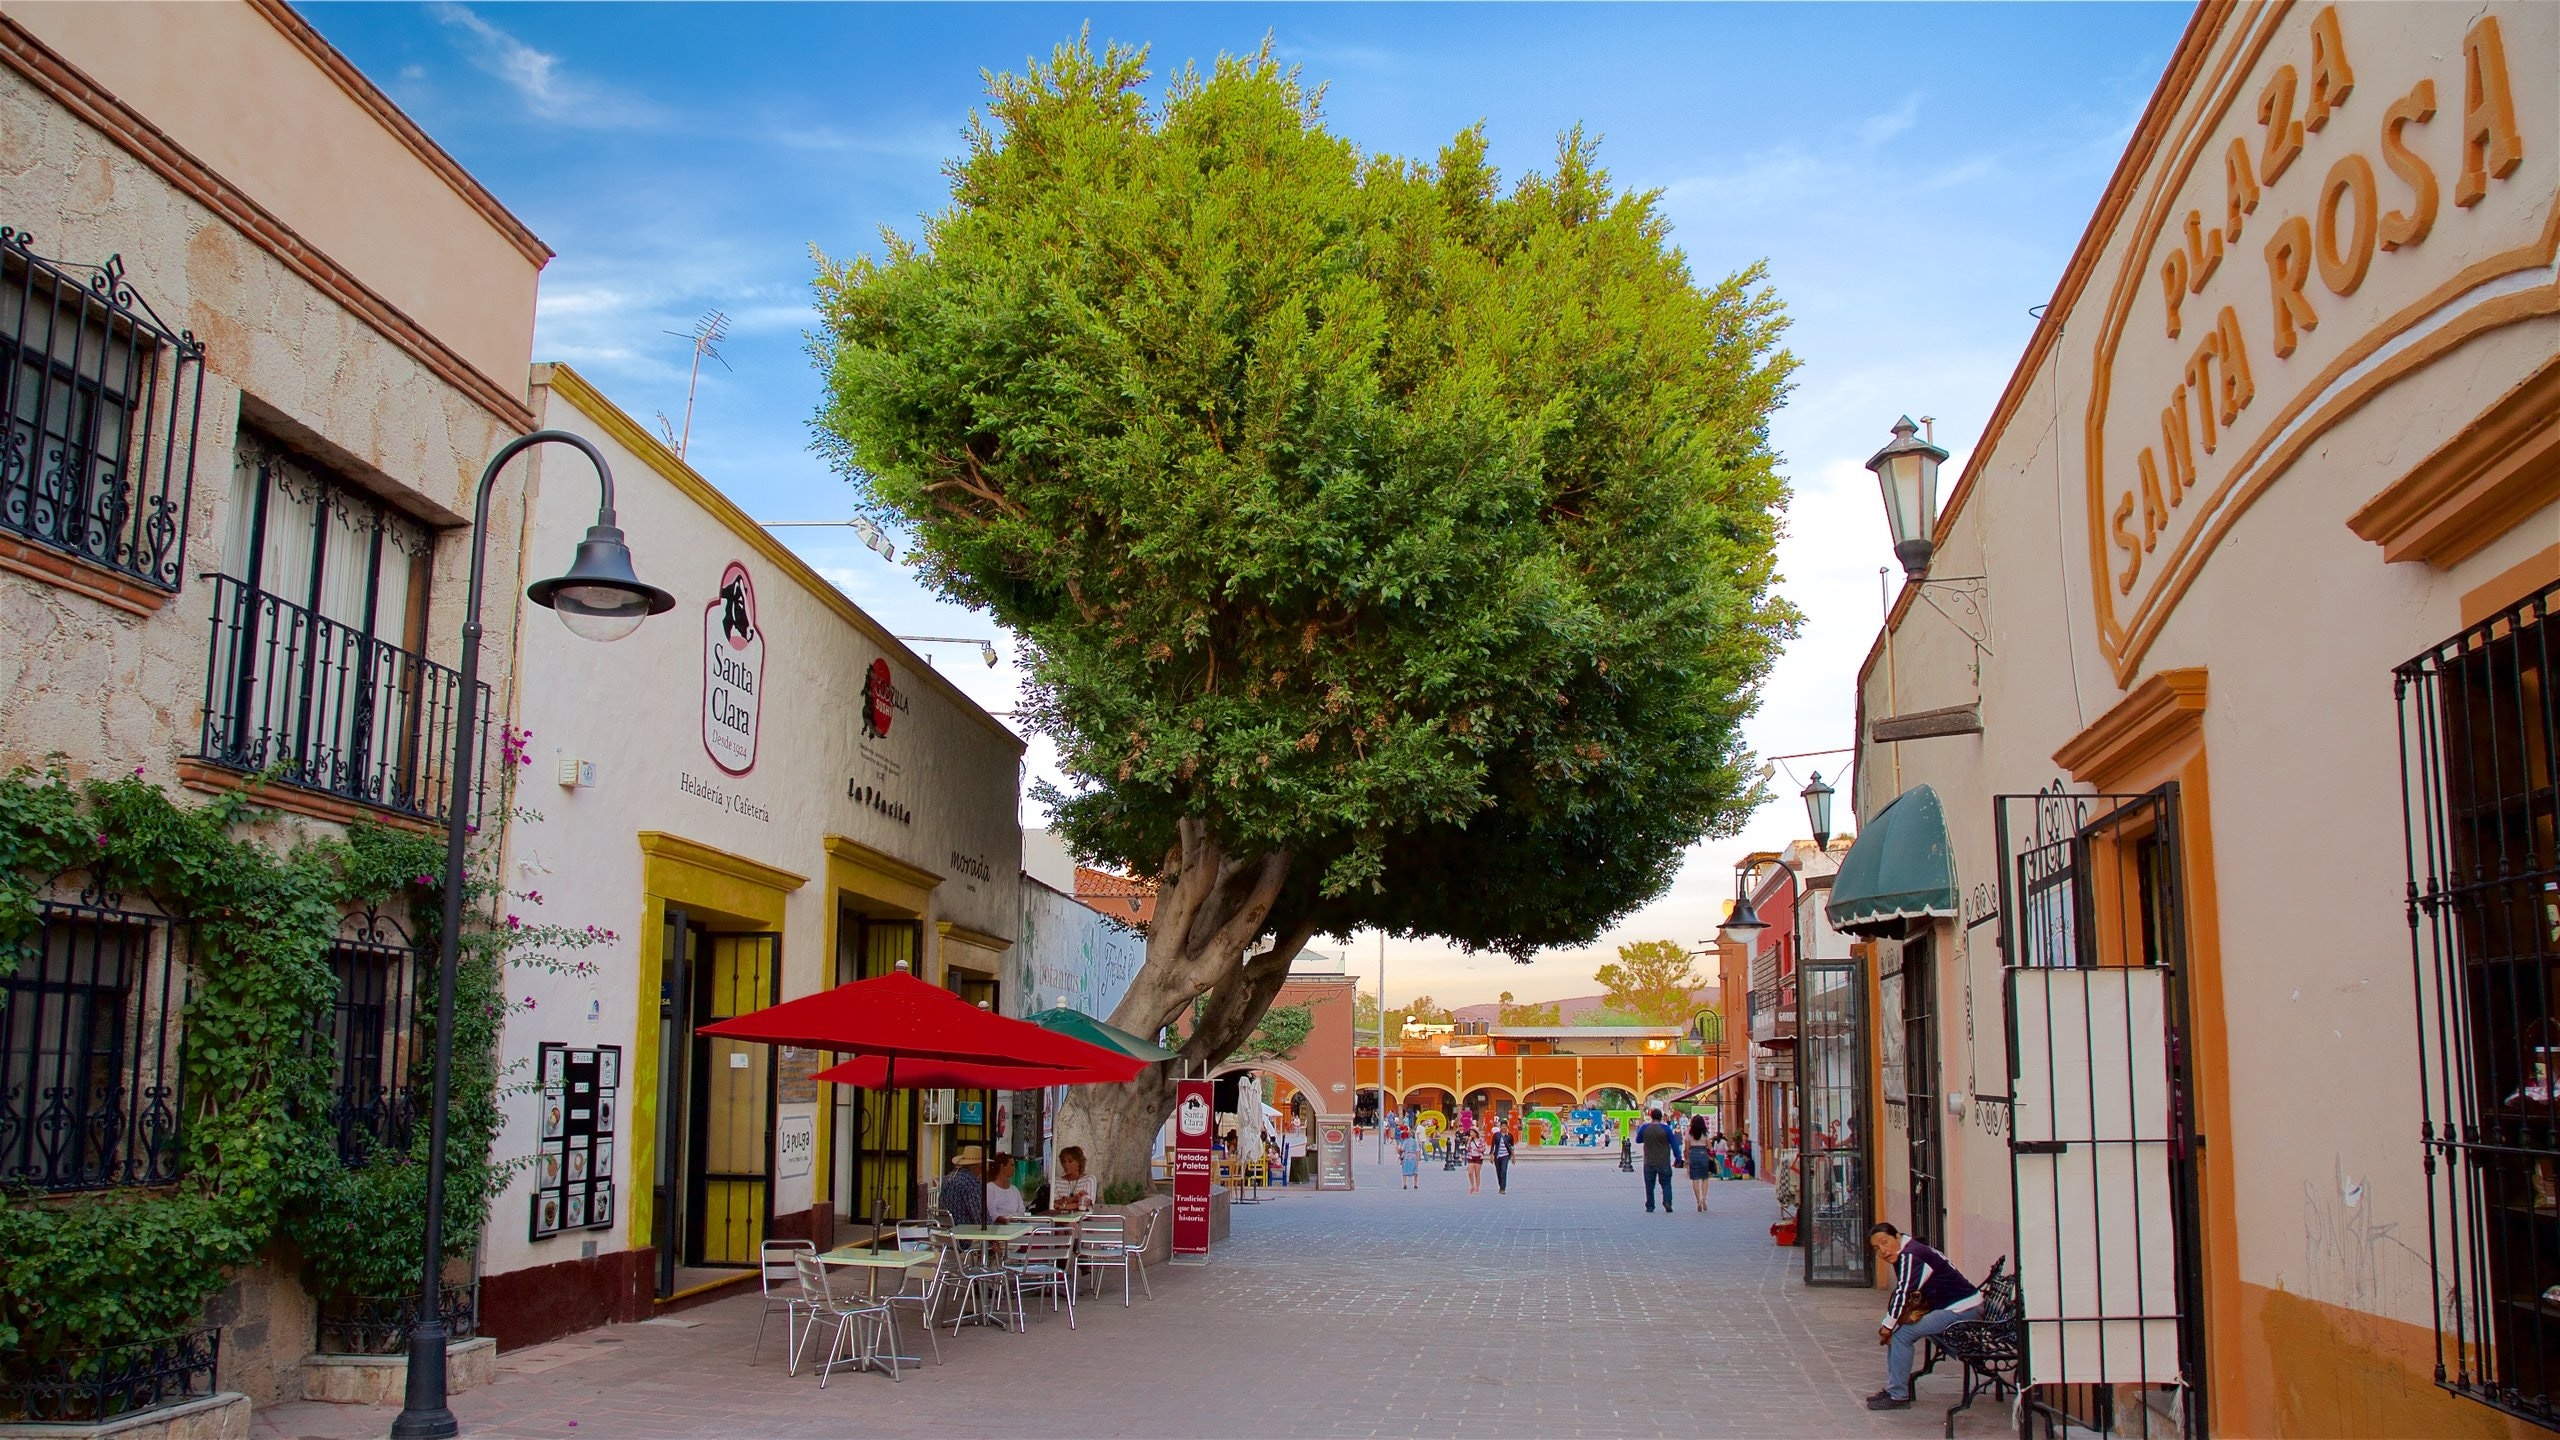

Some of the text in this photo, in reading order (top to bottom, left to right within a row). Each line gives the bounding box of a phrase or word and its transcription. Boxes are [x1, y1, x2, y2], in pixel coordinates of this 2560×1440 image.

[2160, 5, 2355, 340] PLAZA
[2112, 14, 2523, 596] SANTA ROSA
[713, 642, 753, 696] Santa
[712, 687, 750, 736] Clara
[712, 729, 747, 760] Desde 1924
[680, 772, 770, 823] Heladería y Cafetería
[1183, 1119, 1204, 1127] Clara
[1184, 1110, 1204, 1119] Santa
[1177, 1153, 1208, 1162] Helados
[1182, 1162, 1209, 1170] Paletas
[1176, 1194, 1208, 1203] Tradición
[1190, 1204, 1206, 1212] hace
